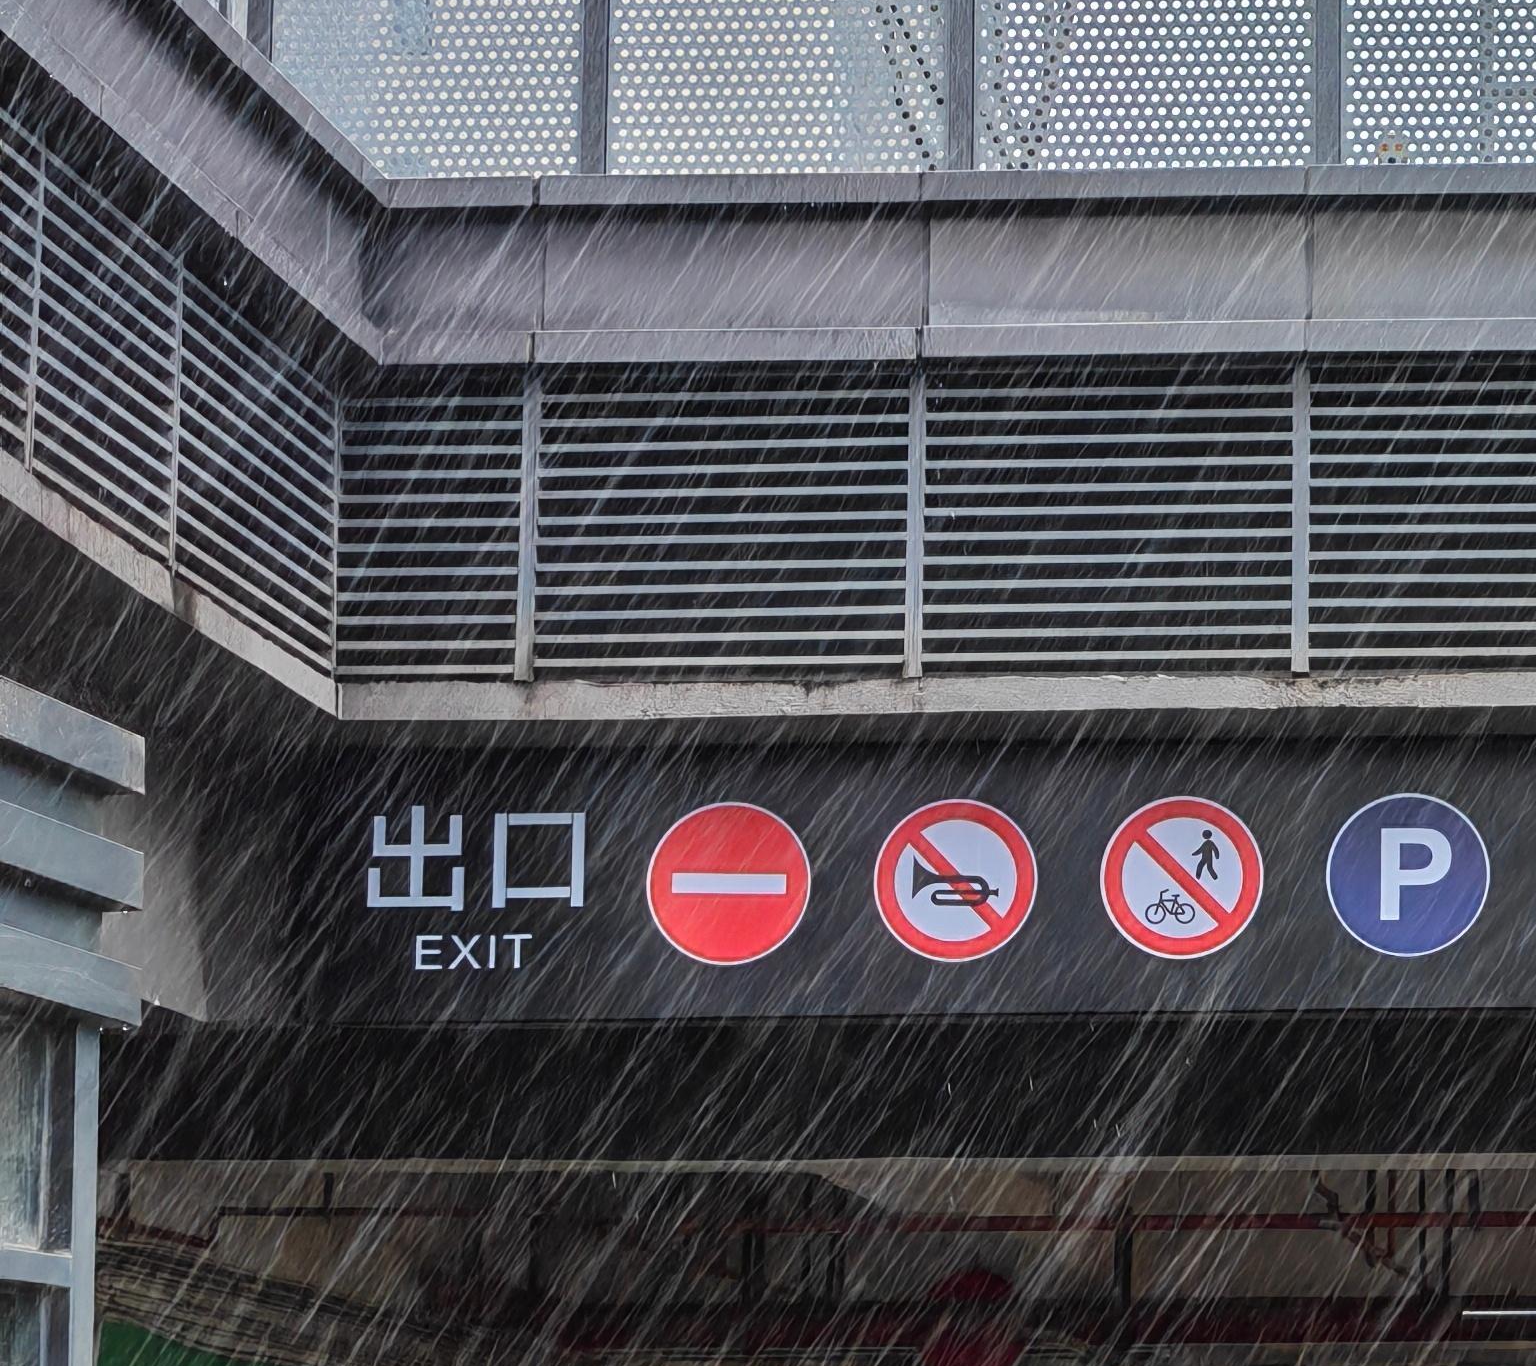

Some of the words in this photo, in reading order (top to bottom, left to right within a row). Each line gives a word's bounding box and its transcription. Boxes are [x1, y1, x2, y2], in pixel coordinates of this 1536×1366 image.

[367, 805, 586, 911] 出口
[1379, 826, 1453, 922] P
[414, 933, 534, 971] EXIT
